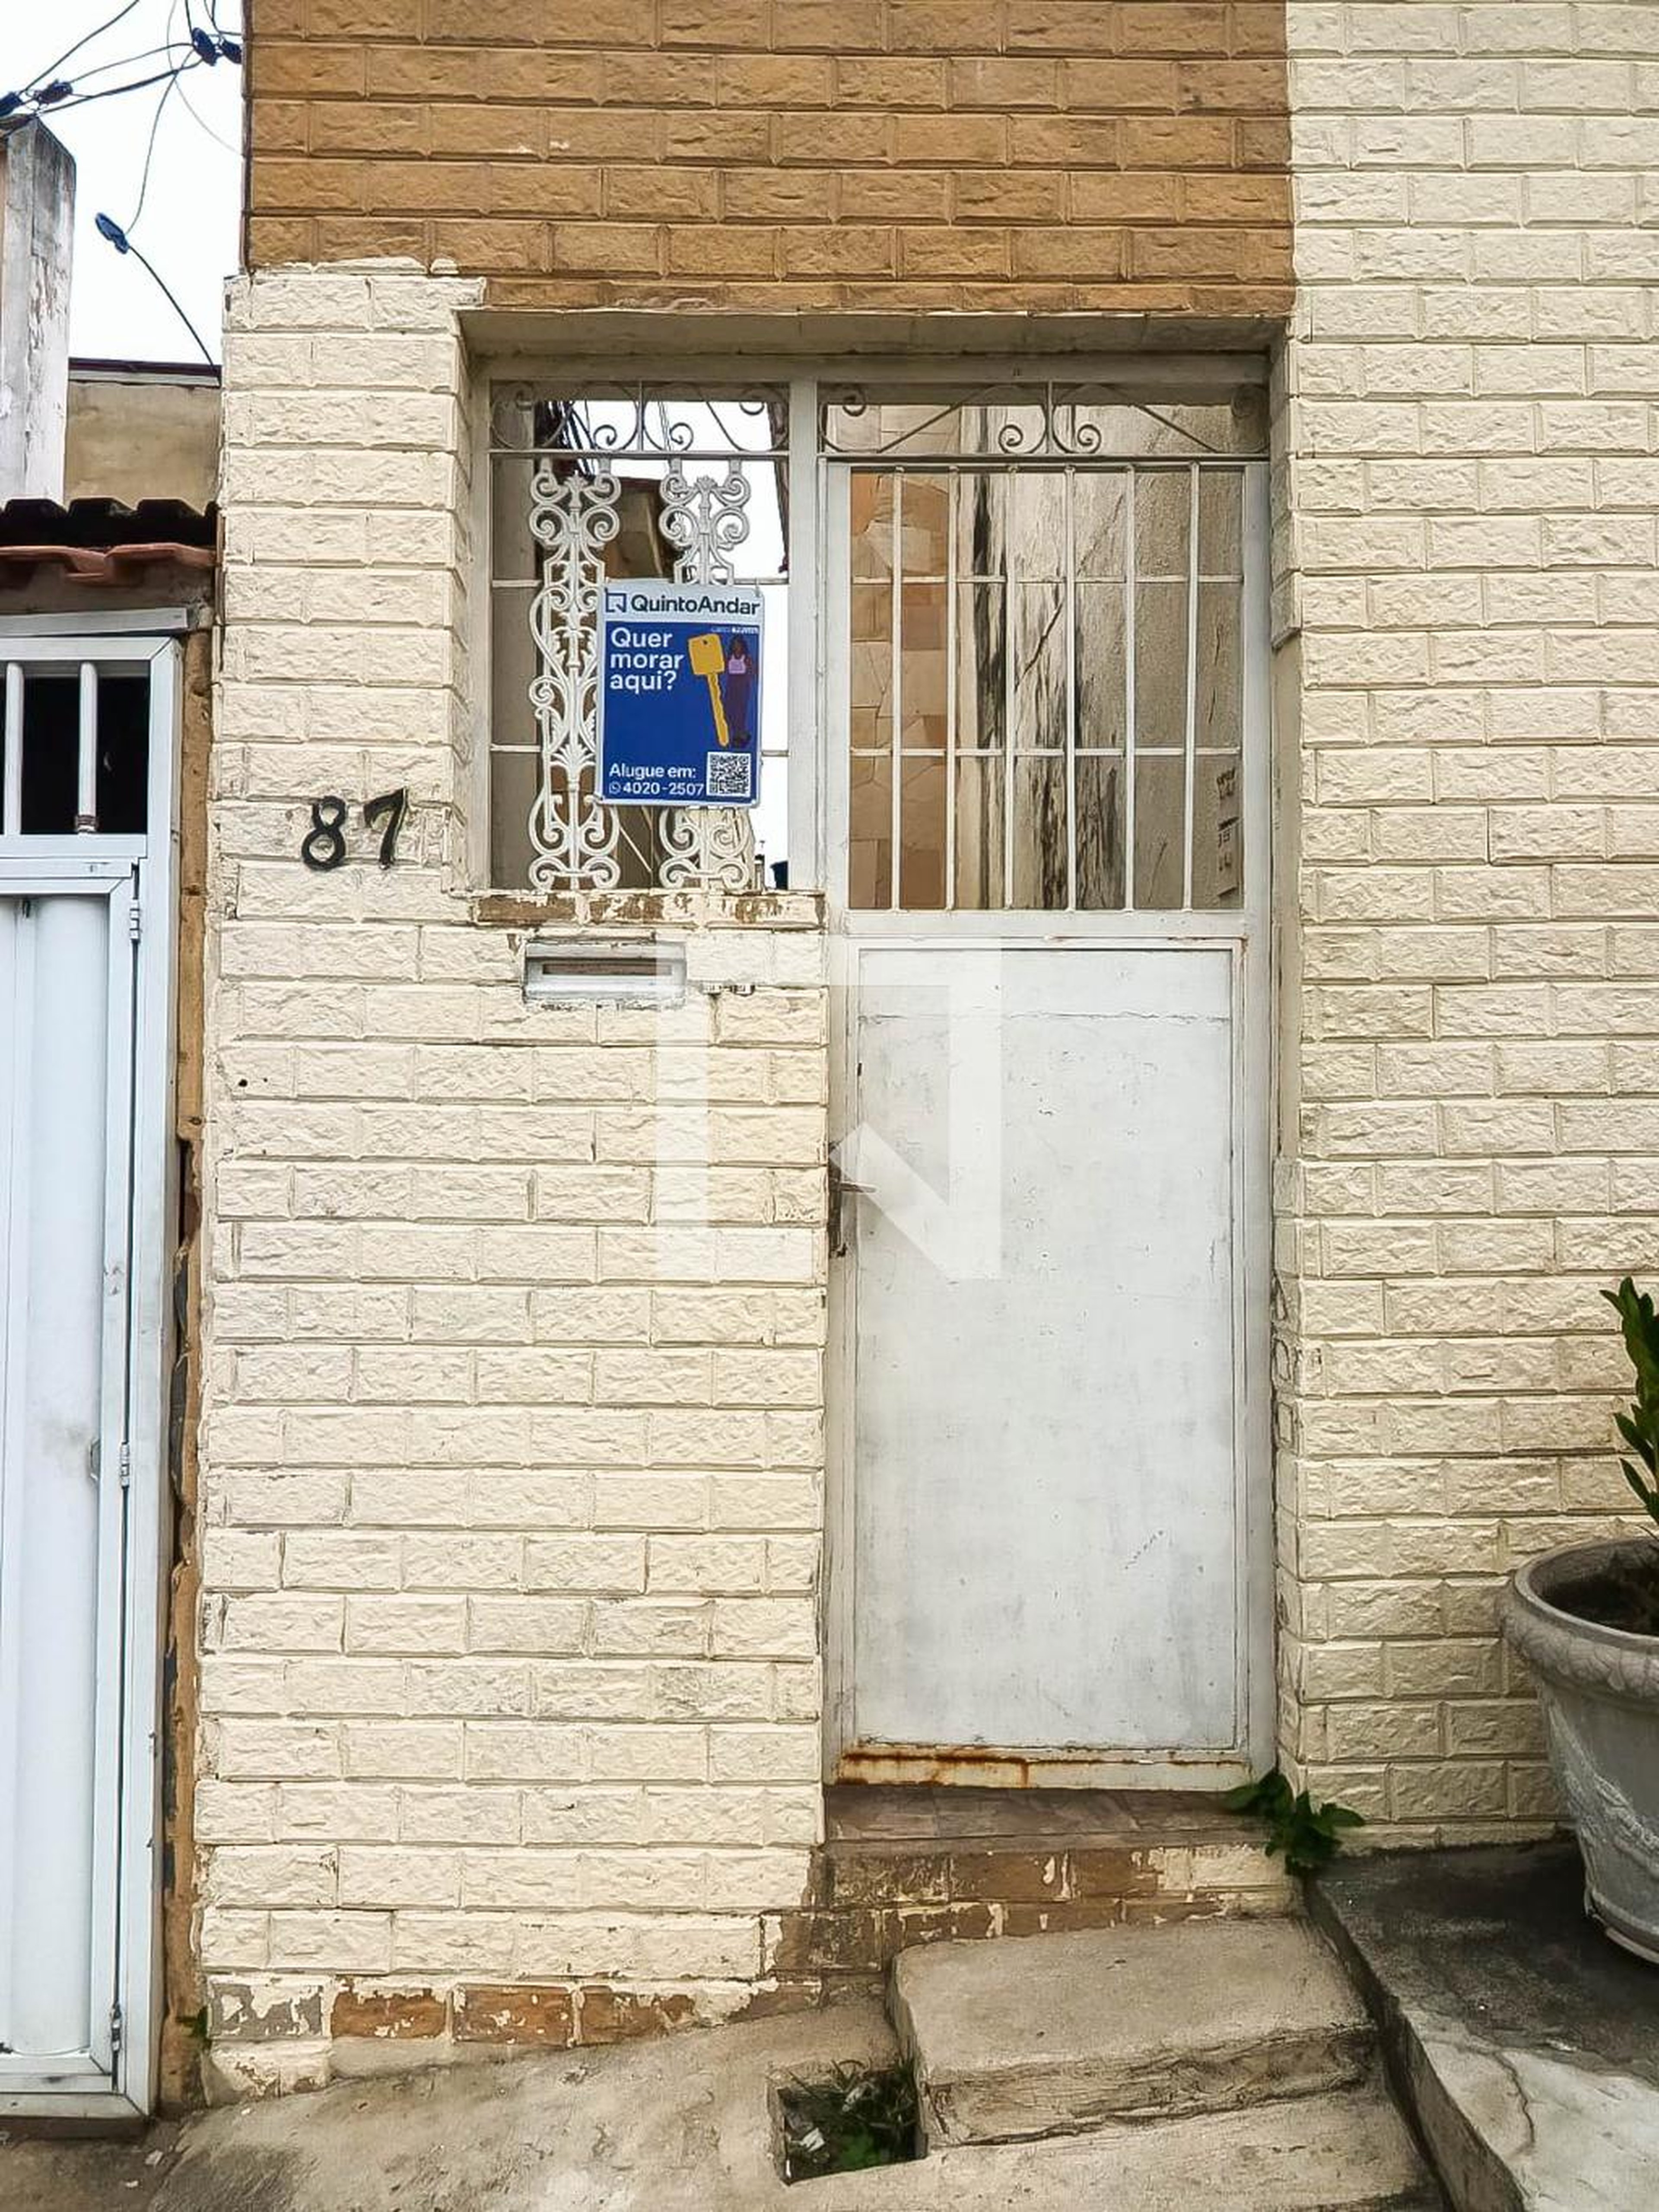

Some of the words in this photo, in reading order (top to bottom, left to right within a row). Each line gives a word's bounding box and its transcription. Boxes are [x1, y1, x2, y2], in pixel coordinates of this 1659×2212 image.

[631, 594, 760, 615] QuintoAndar
[610, 627, 673, 648] Quer
[610, 653, 684, 670] morar
[609, 671, 677, 694] aqui?
[609, 763, 664, 780] Alugue
[667, 767, 696, 779] em:
[623, 781, 704, 796] 4020-2507
[302, 786, 408, 871] 87
